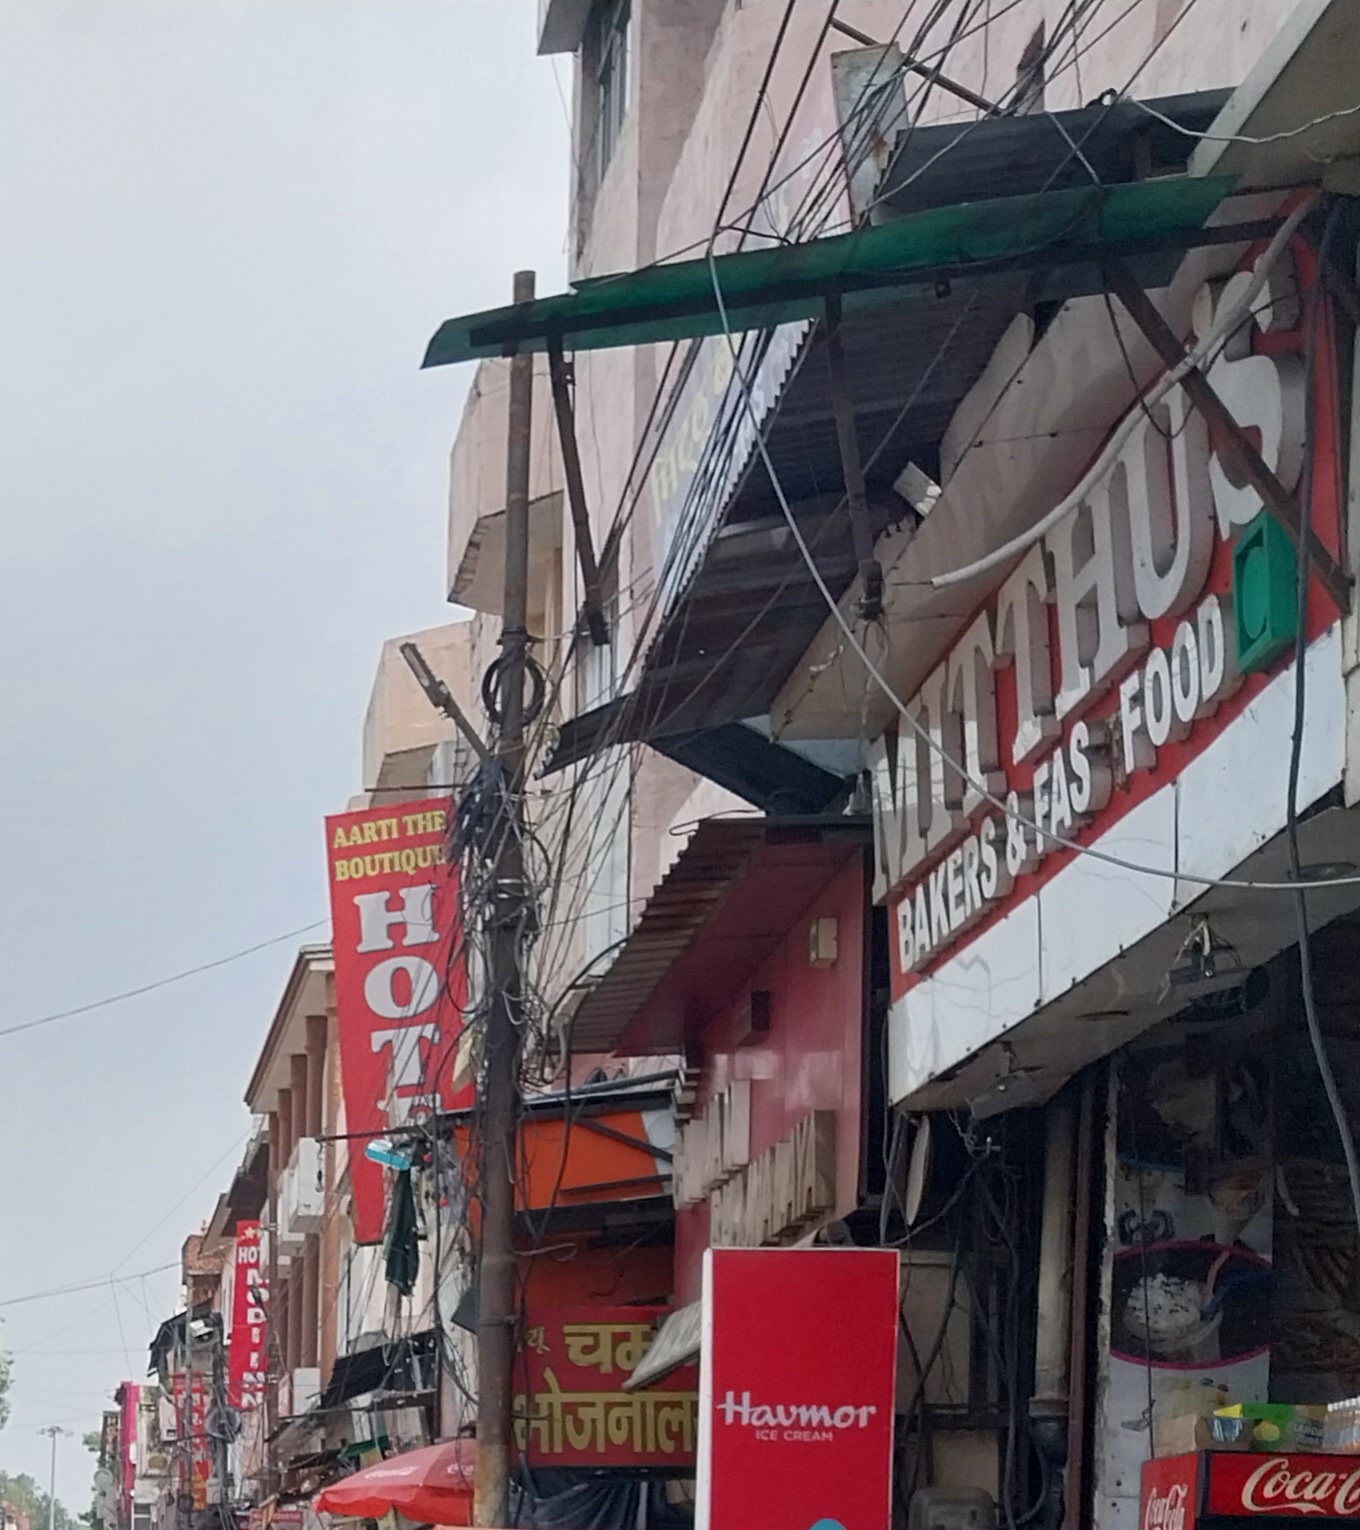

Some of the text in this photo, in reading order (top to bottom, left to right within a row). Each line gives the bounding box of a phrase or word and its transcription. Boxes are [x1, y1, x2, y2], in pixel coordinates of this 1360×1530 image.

[896, 822, 999, 975] BAKERS
[1005, 792, 1028, 878] &
[1120, 591, 1226, 774] FOOD
[333, 810, 446, 849] AARTI THE
[513, 1367, 698, 1454] भोजनाल
[716, 1390, 877, 1429] Havmor
[756, 1430, 834, 1442] ICE CREAM
